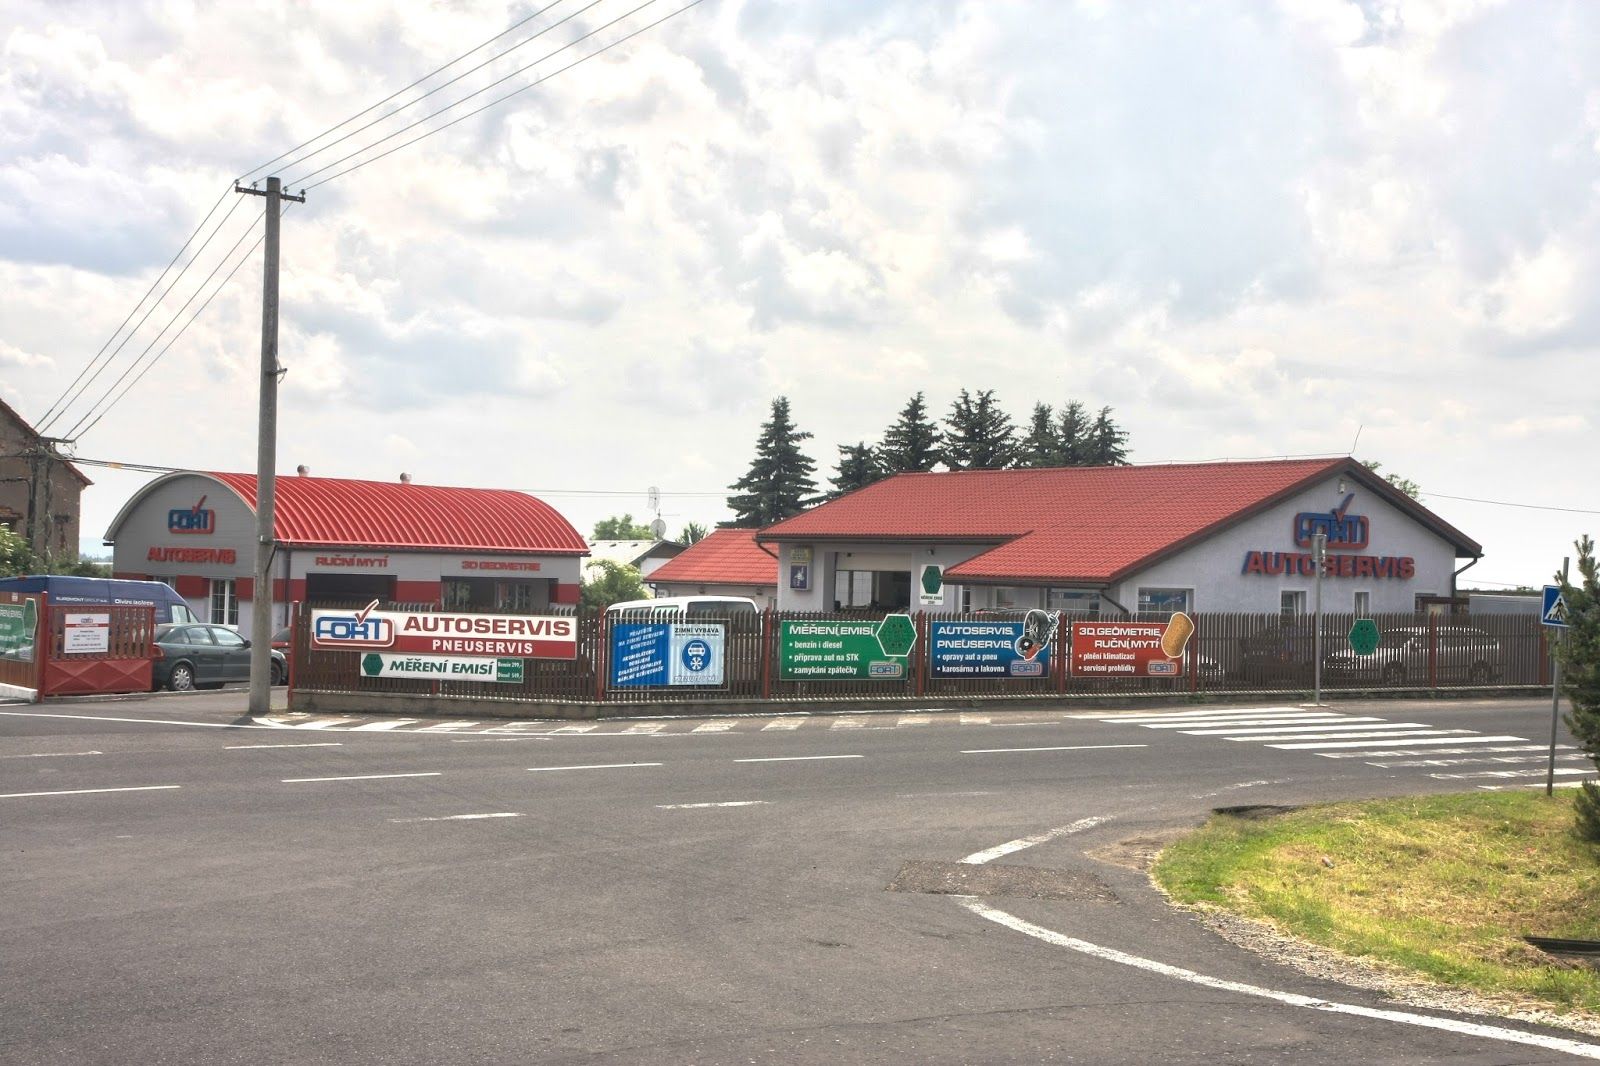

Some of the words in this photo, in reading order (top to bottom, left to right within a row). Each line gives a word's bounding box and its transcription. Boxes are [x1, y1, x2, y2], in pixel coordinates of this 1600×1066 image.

[147, 547, 236, 564] AUTOSERVIS
[316, 554, 356, 567] RUČNÍ
[357, 554, 389, 568] MYTÍ
[316, 616, 384, 641] FORT
[403, 616, 571, 637] AUTOSERVIS
[789, 623, 840, 637] MĚŘENÍ
[840, 624, 875, 637] EMISÍ
[937, 626, 1014, 636] AUTOSERVIS
[1078, 627, 1095, 636] 3D
[1096, 627, 1161, 637] GEOMETRIE
[432, 640, 533, 654] PNEUSERVIS
[822, 641, 843, 649] diesel
[937, 638, 1012, 649] PNEUSERVIS
[1094, 638, 1131, 649] RUČNÍ
[1131, 638, 1160, 649] MYTÍ
[846, 653, 859, 661] STK
[942, 654, 963, 662] opravy
[389, 658, 449, 673] MĚŘENÍ
[451, 662, 495, 675] EMISÍ
[794, 665, 827, 675] zamykání
[827, 665, 858, 675] zpátečky
